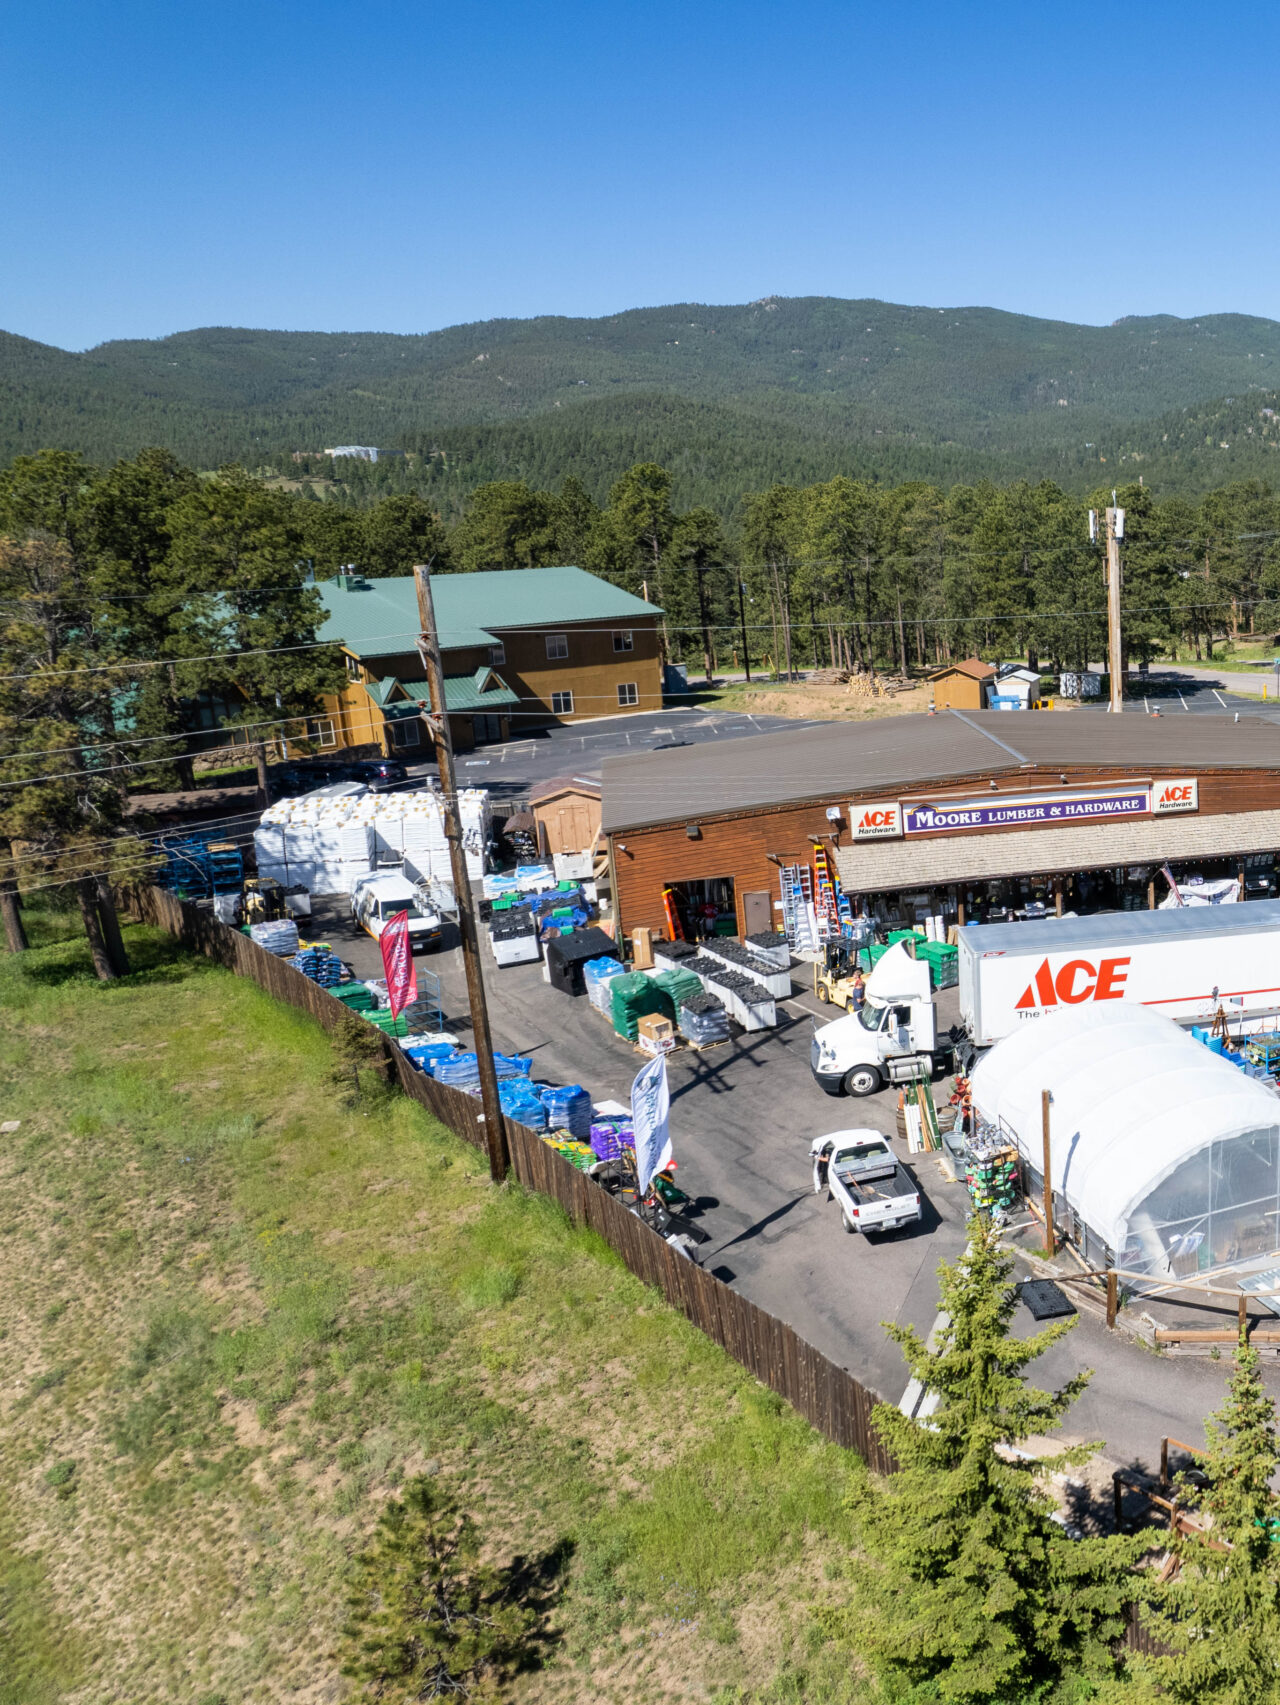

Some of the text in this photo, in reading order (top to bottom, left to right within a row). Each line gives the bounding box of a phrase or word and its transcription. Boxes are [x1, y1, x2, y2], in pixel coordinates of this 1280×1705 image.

[1159, 786, 1193, 802] ACE
[988, 808, 1045, 822] LUMBER
[1050, 807, 1062, 816] &
[1066, 800, 1140, 815] HARDWARE
[1159, 801, 1193, 809] Hardware
[858, 811, 896, 827] ACE
[858, 827, 896, 835] Hardware
[1014, 957, 1131, 1009] ACE
[1017, 1010, 1040, 1019] The
